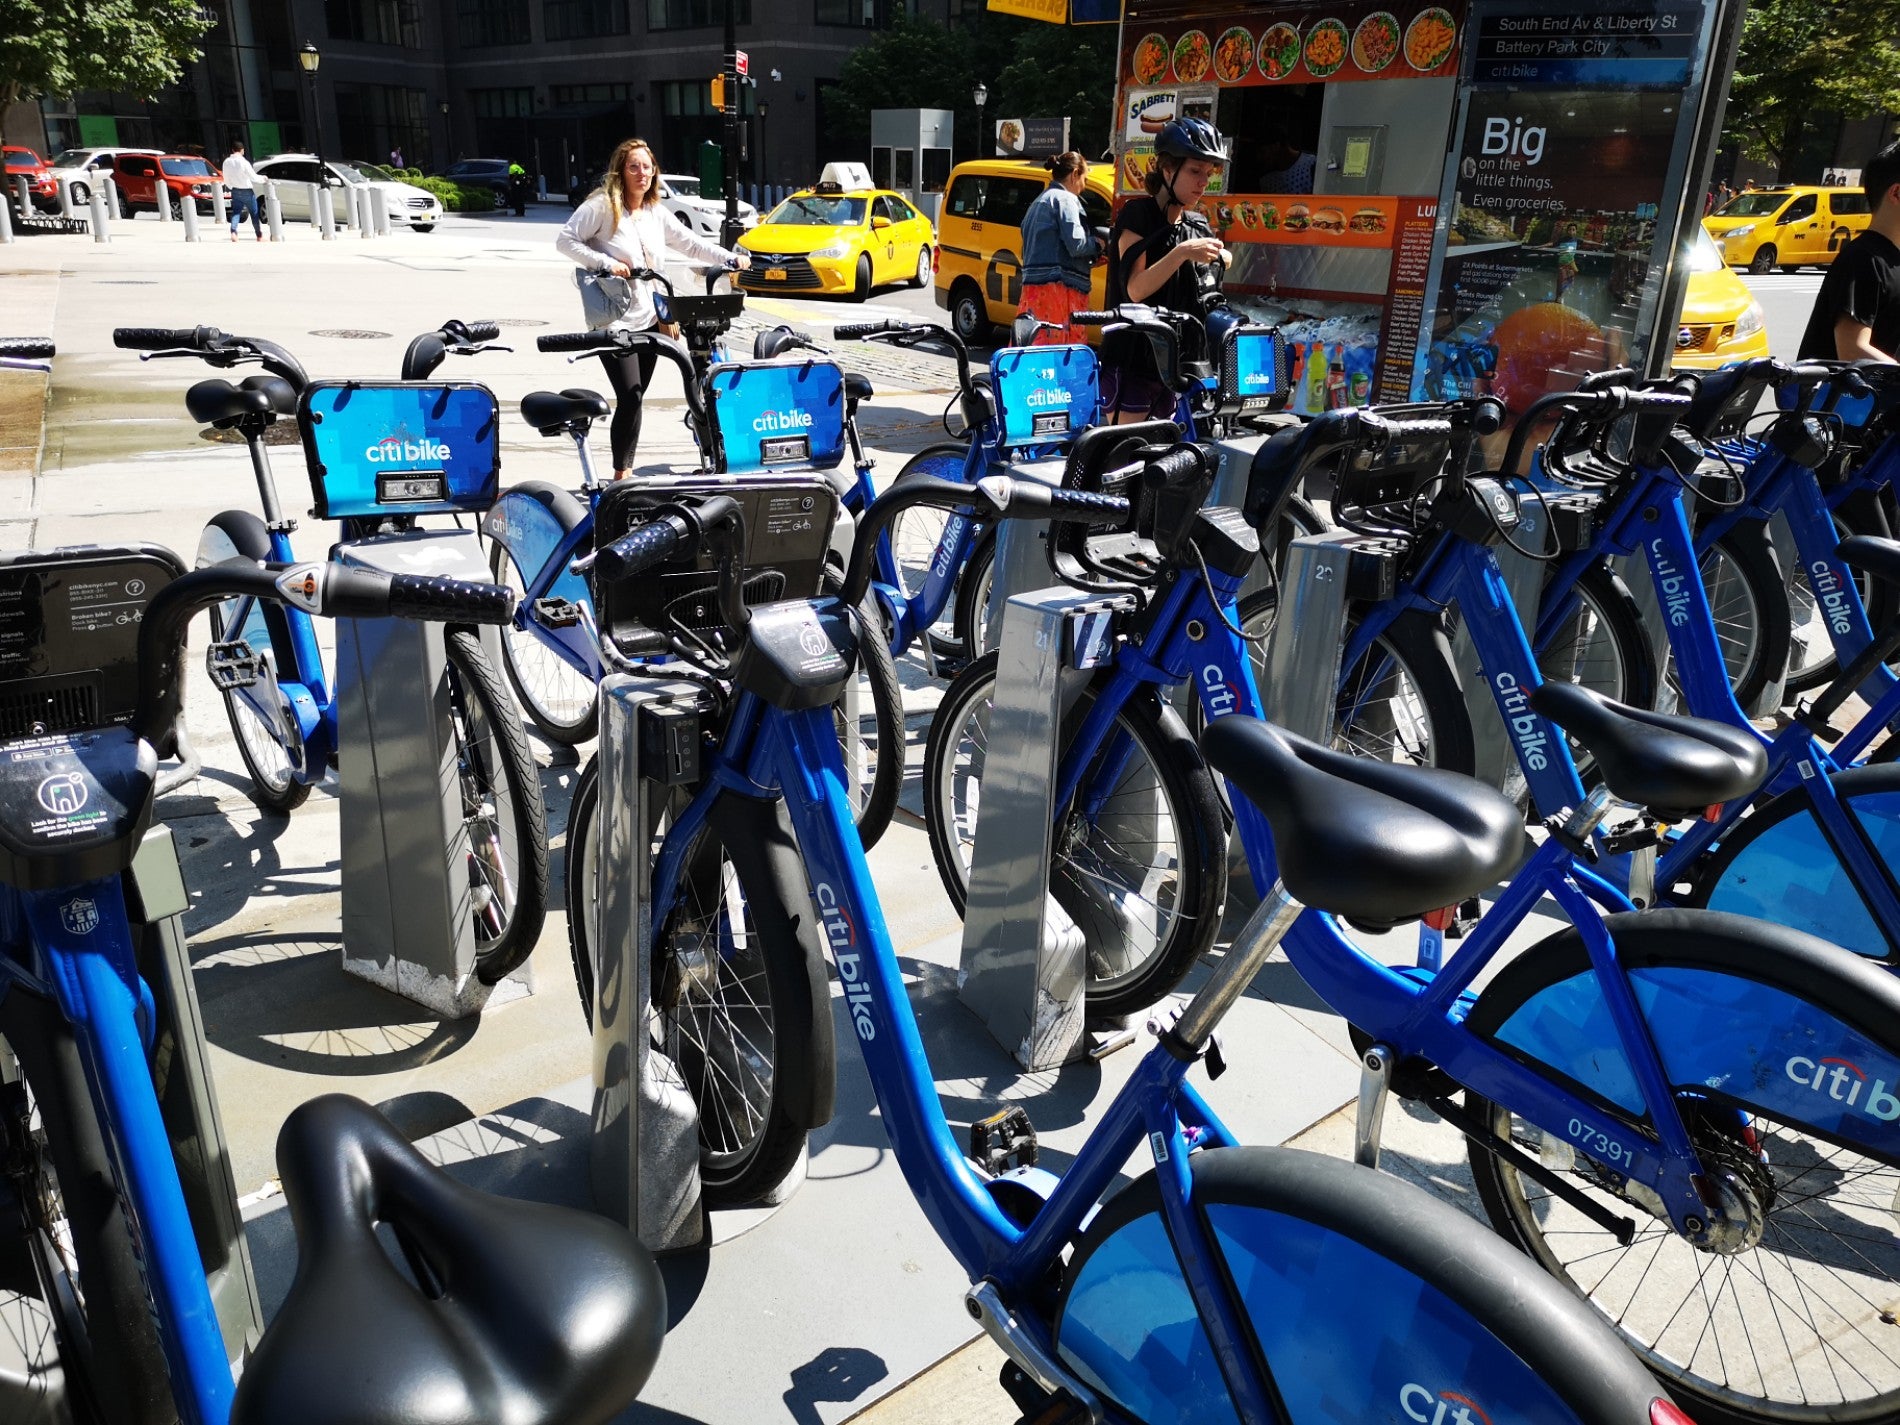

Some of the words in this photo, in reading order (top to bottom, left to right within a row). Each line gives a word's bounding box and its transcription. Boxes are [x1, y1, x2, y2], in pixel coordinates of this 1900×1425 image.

[1499, 18, 1539, 31] South
[1542, 17, 1569, 30] End
[1572, 17, 1590, 29] Av
[1593, 17, 1603, 29] &
[1607, 15, 1657, 31] Liberty
[1661, 14, 1678, 28] St
[1496, 40, 1544, 56] Battery
[1547, 40, 1578, 52] Park
[1582, 40, 1610, 55] City
[1130, 94, 1175, 119] SABRETT
[1481, 116, 1547, 165] Big
[1478, 158, 1495, 170] on
[1500, 157, 1521, 171] the
[1475, 174, 1505, 187] little
[1510, 175, 1554, 191] things.
[1473, 194, 1501, 208] Even
[1505, 196, 1567, 211] groceries.
[1458, 381, 1471, 389] Citi
[71, 613, 94, 621] Broken
[95, 611, 112, 619] bike?
[67, 820, 80, 828] bike
[92, 816, 108, 824] been
[68, 813, 85, 822] green
[85, 811, 99, 820] light
[47, 829, 72, 838] securely
[1568, 1117, 1633, 1169] 07391
